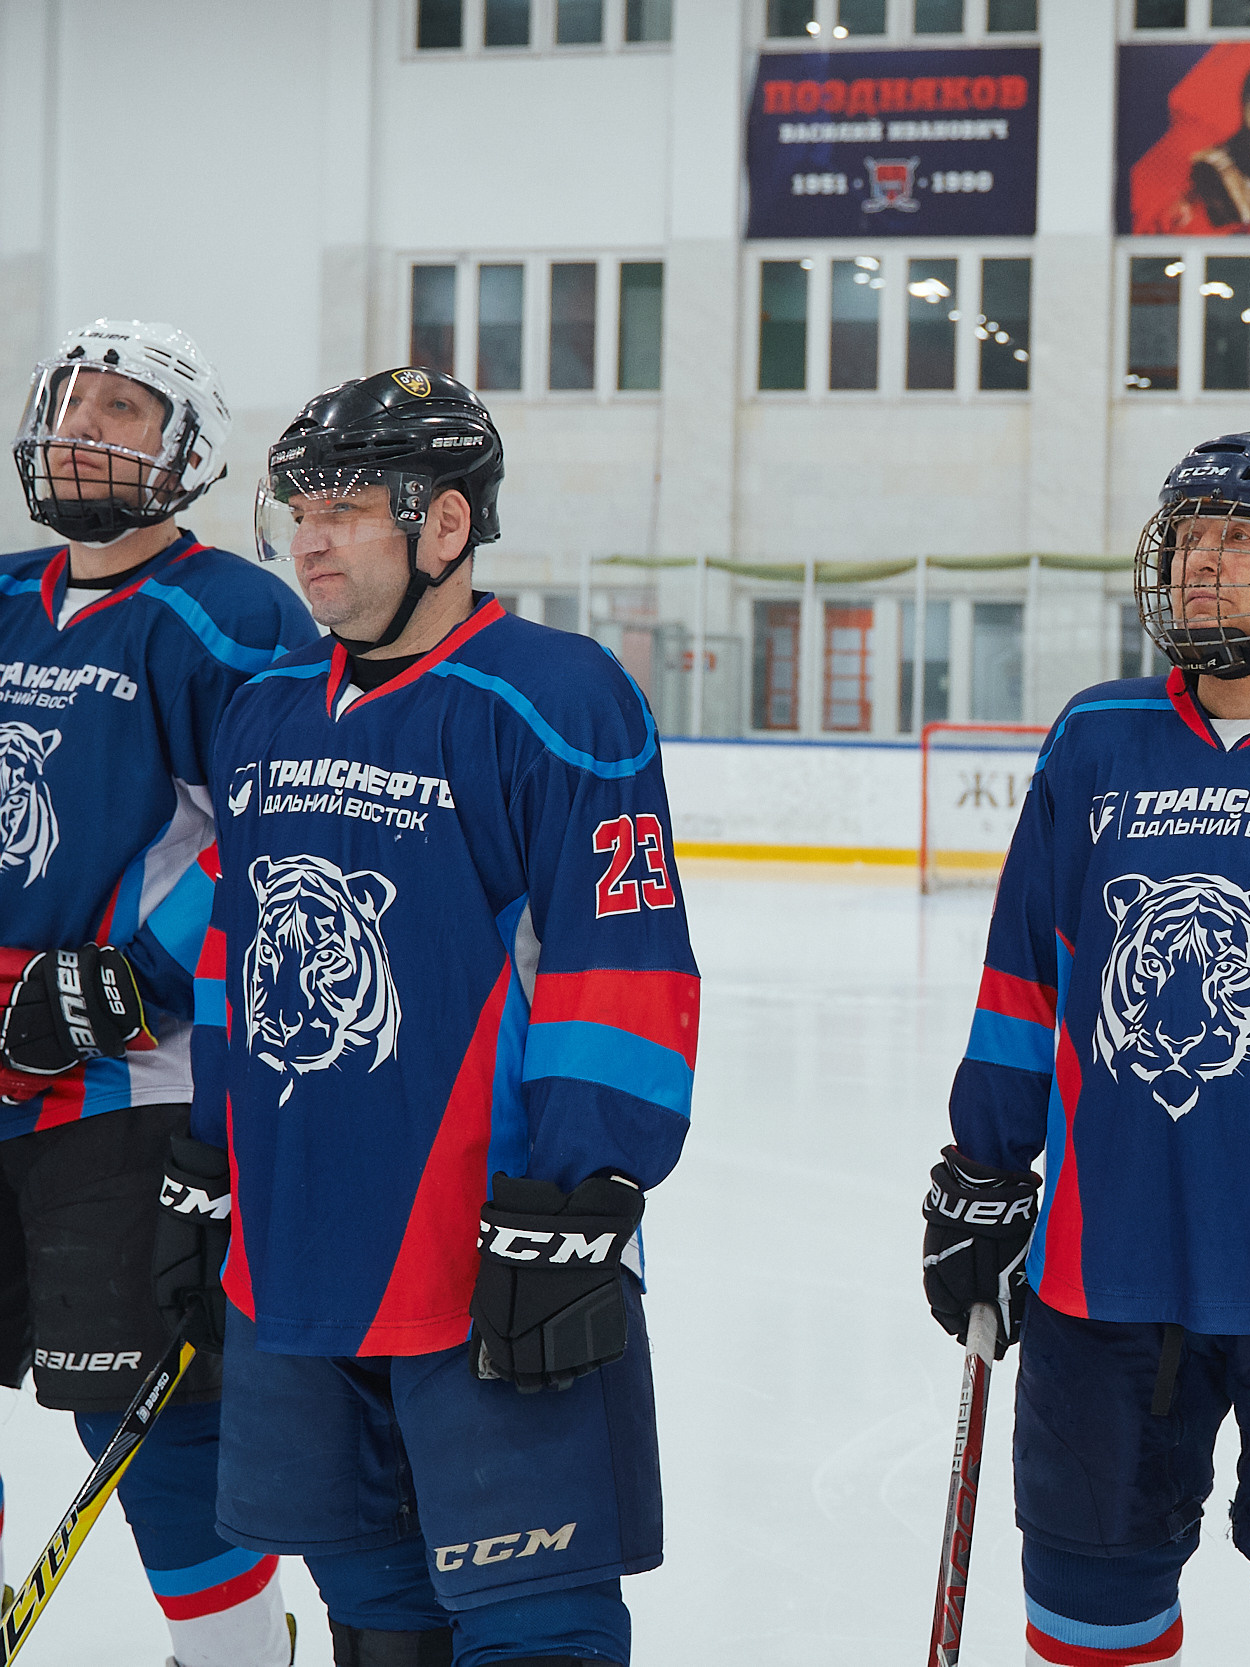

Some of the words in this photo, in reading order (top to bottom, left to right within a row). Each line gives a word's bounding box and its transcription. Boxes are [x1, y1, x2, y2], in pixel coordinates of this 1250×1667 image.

[764, 75, 1028, 117] ПОЗДНЯКОВ
[1178, 465, 1230, 479] CCM
[269, 758, 455, 809] ТРАНСНЕФТЬ
[263, 788, 344, 814] ДАЛЬНИЙ
[343, 797, 428, 832] ВОСТОК
[1127, 812, 1241, 838] ДАЛЬНИЙ
[592, 813, 676, 919] 23
[57, 949, 103, 1061] BAUER
[34, 1348, 142, 1372] BAUER
[434, 1522, 577, 1572] CCM
